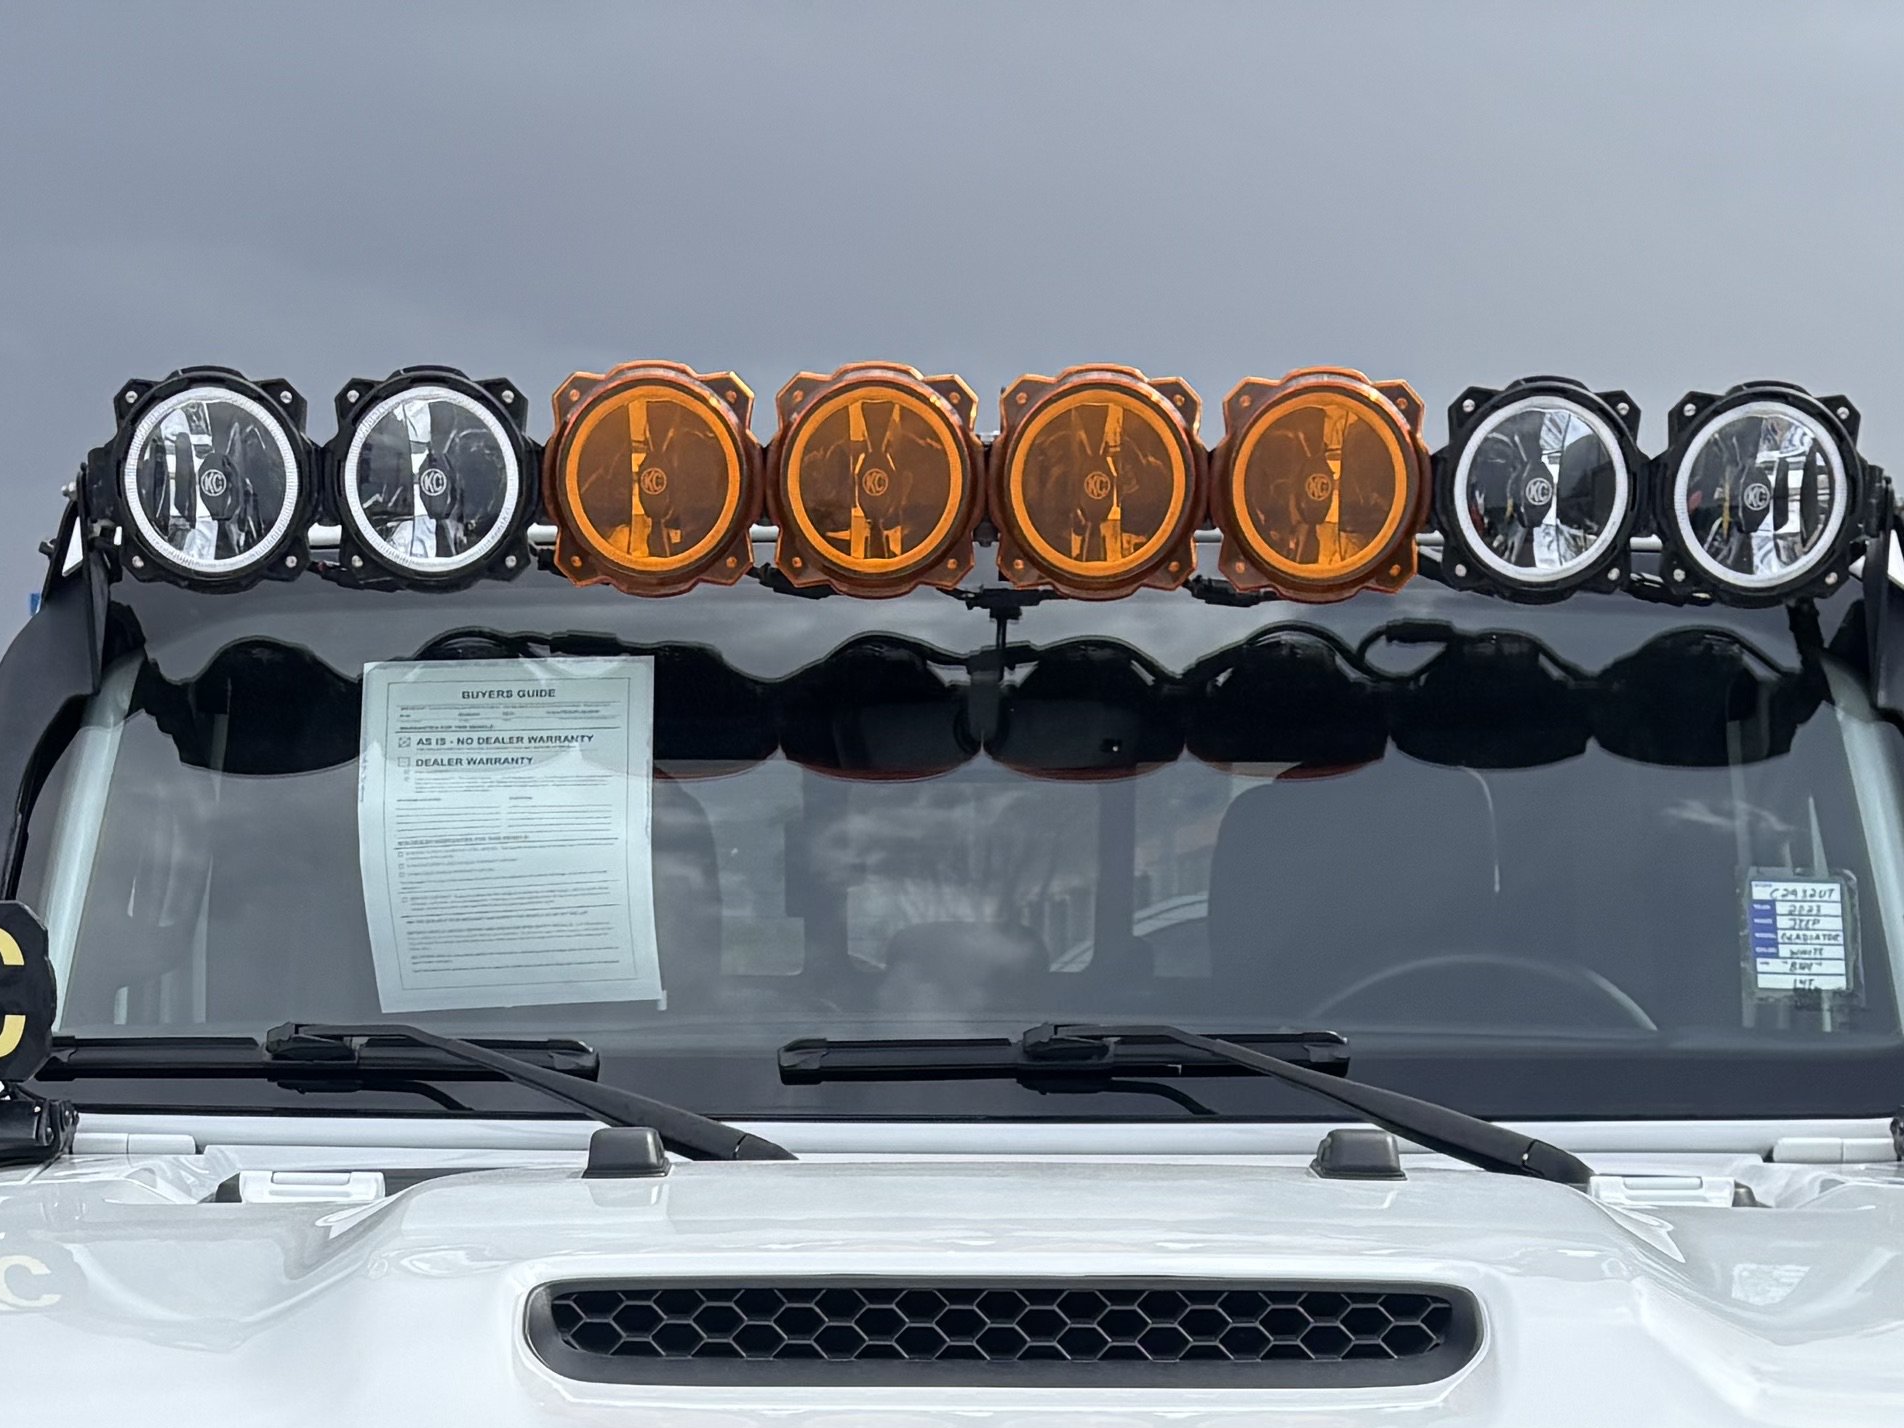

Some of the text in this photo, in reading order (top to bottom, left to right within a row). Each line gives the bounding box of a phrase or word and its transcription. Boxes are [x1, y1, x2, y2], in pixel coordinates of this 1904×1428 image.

[203, 471, 224, 493] KC
[423, 471, 443, 493] KC
[644, 470, 664, 492] KC
[865, 471, 886, 493] KC
[1086, 475, 1108, 497] KC
[1309, 477, 1329, 499] KC
[1529, 480, 1550, 503] KC
[1746, 486, 1768, 509] KC
[462, 688, 556, 700] BUYERS GUIDE
[416, 737, 432, 746] AS
[435, 737, 446, 746] IS
[457, 736, 474, 745] NO
[477, 736, 524, 745] DEALER
[528, 734, 594, 744] WARRANTY
[415, 756, 533, 767] DEALER WARRANTY
